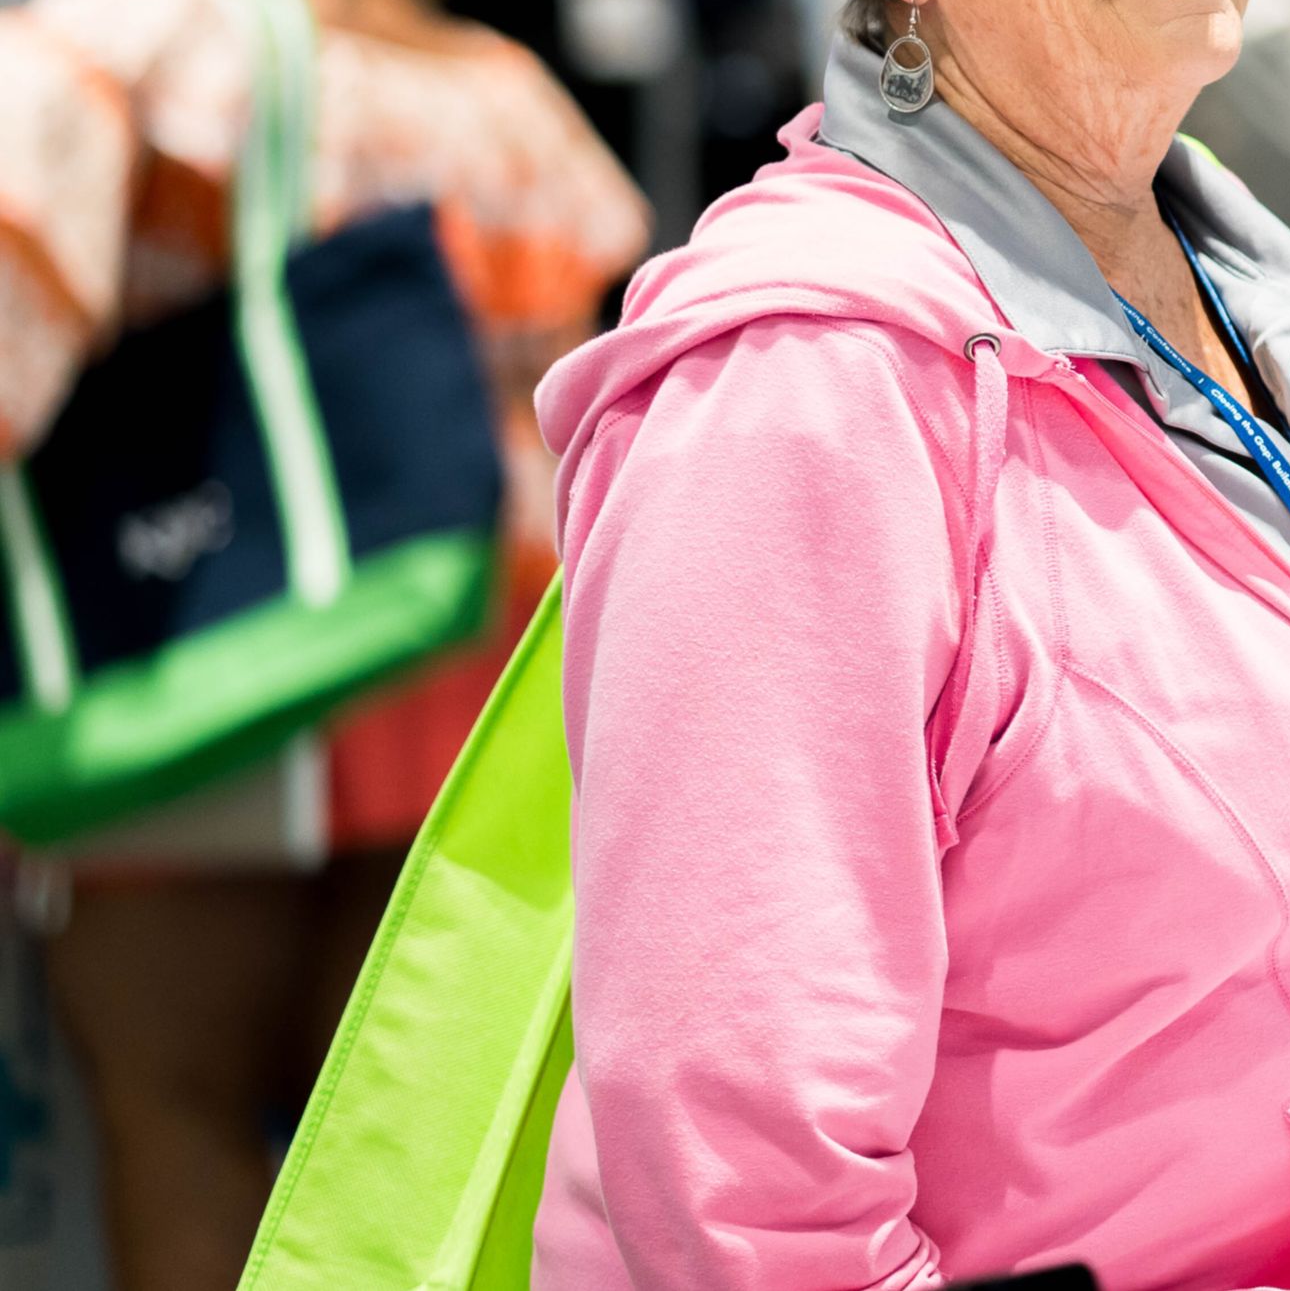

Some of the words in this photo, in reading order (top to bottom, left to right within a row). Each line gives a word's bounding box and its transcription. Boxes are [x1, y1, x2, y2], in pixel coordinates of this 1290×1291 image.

[1146, 326, 1192, 373] Conference
[1210, 388, 1243, 421] Closing
[1241, 420, 1255, 436] the
[1254, 435, 1274, 462] Gap:
